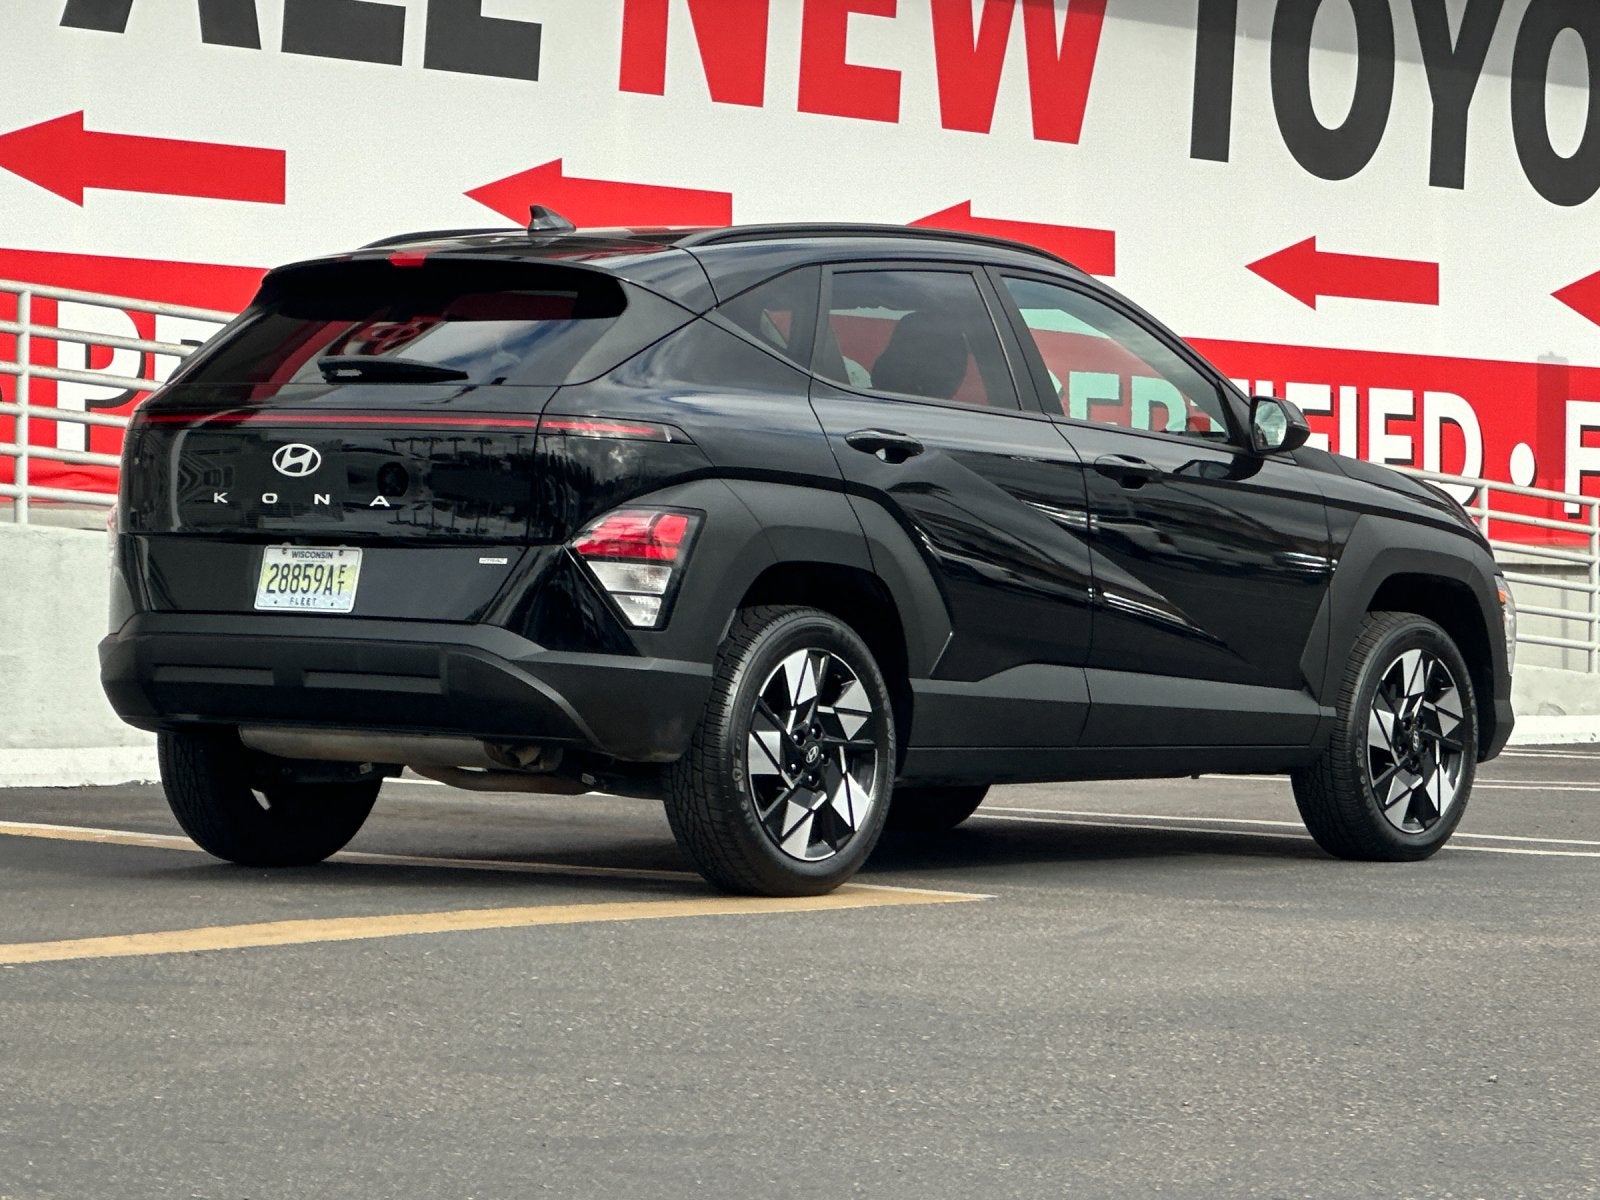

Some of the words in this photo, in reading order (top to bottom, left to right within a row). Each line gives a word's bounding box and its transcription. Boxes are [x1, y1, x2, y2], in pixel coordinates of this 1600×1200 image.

[213, 491, 391, 508] KONA
[291, 550, 334, 559] WISCONSIN
[289, 597, 317, 606] FLEET
